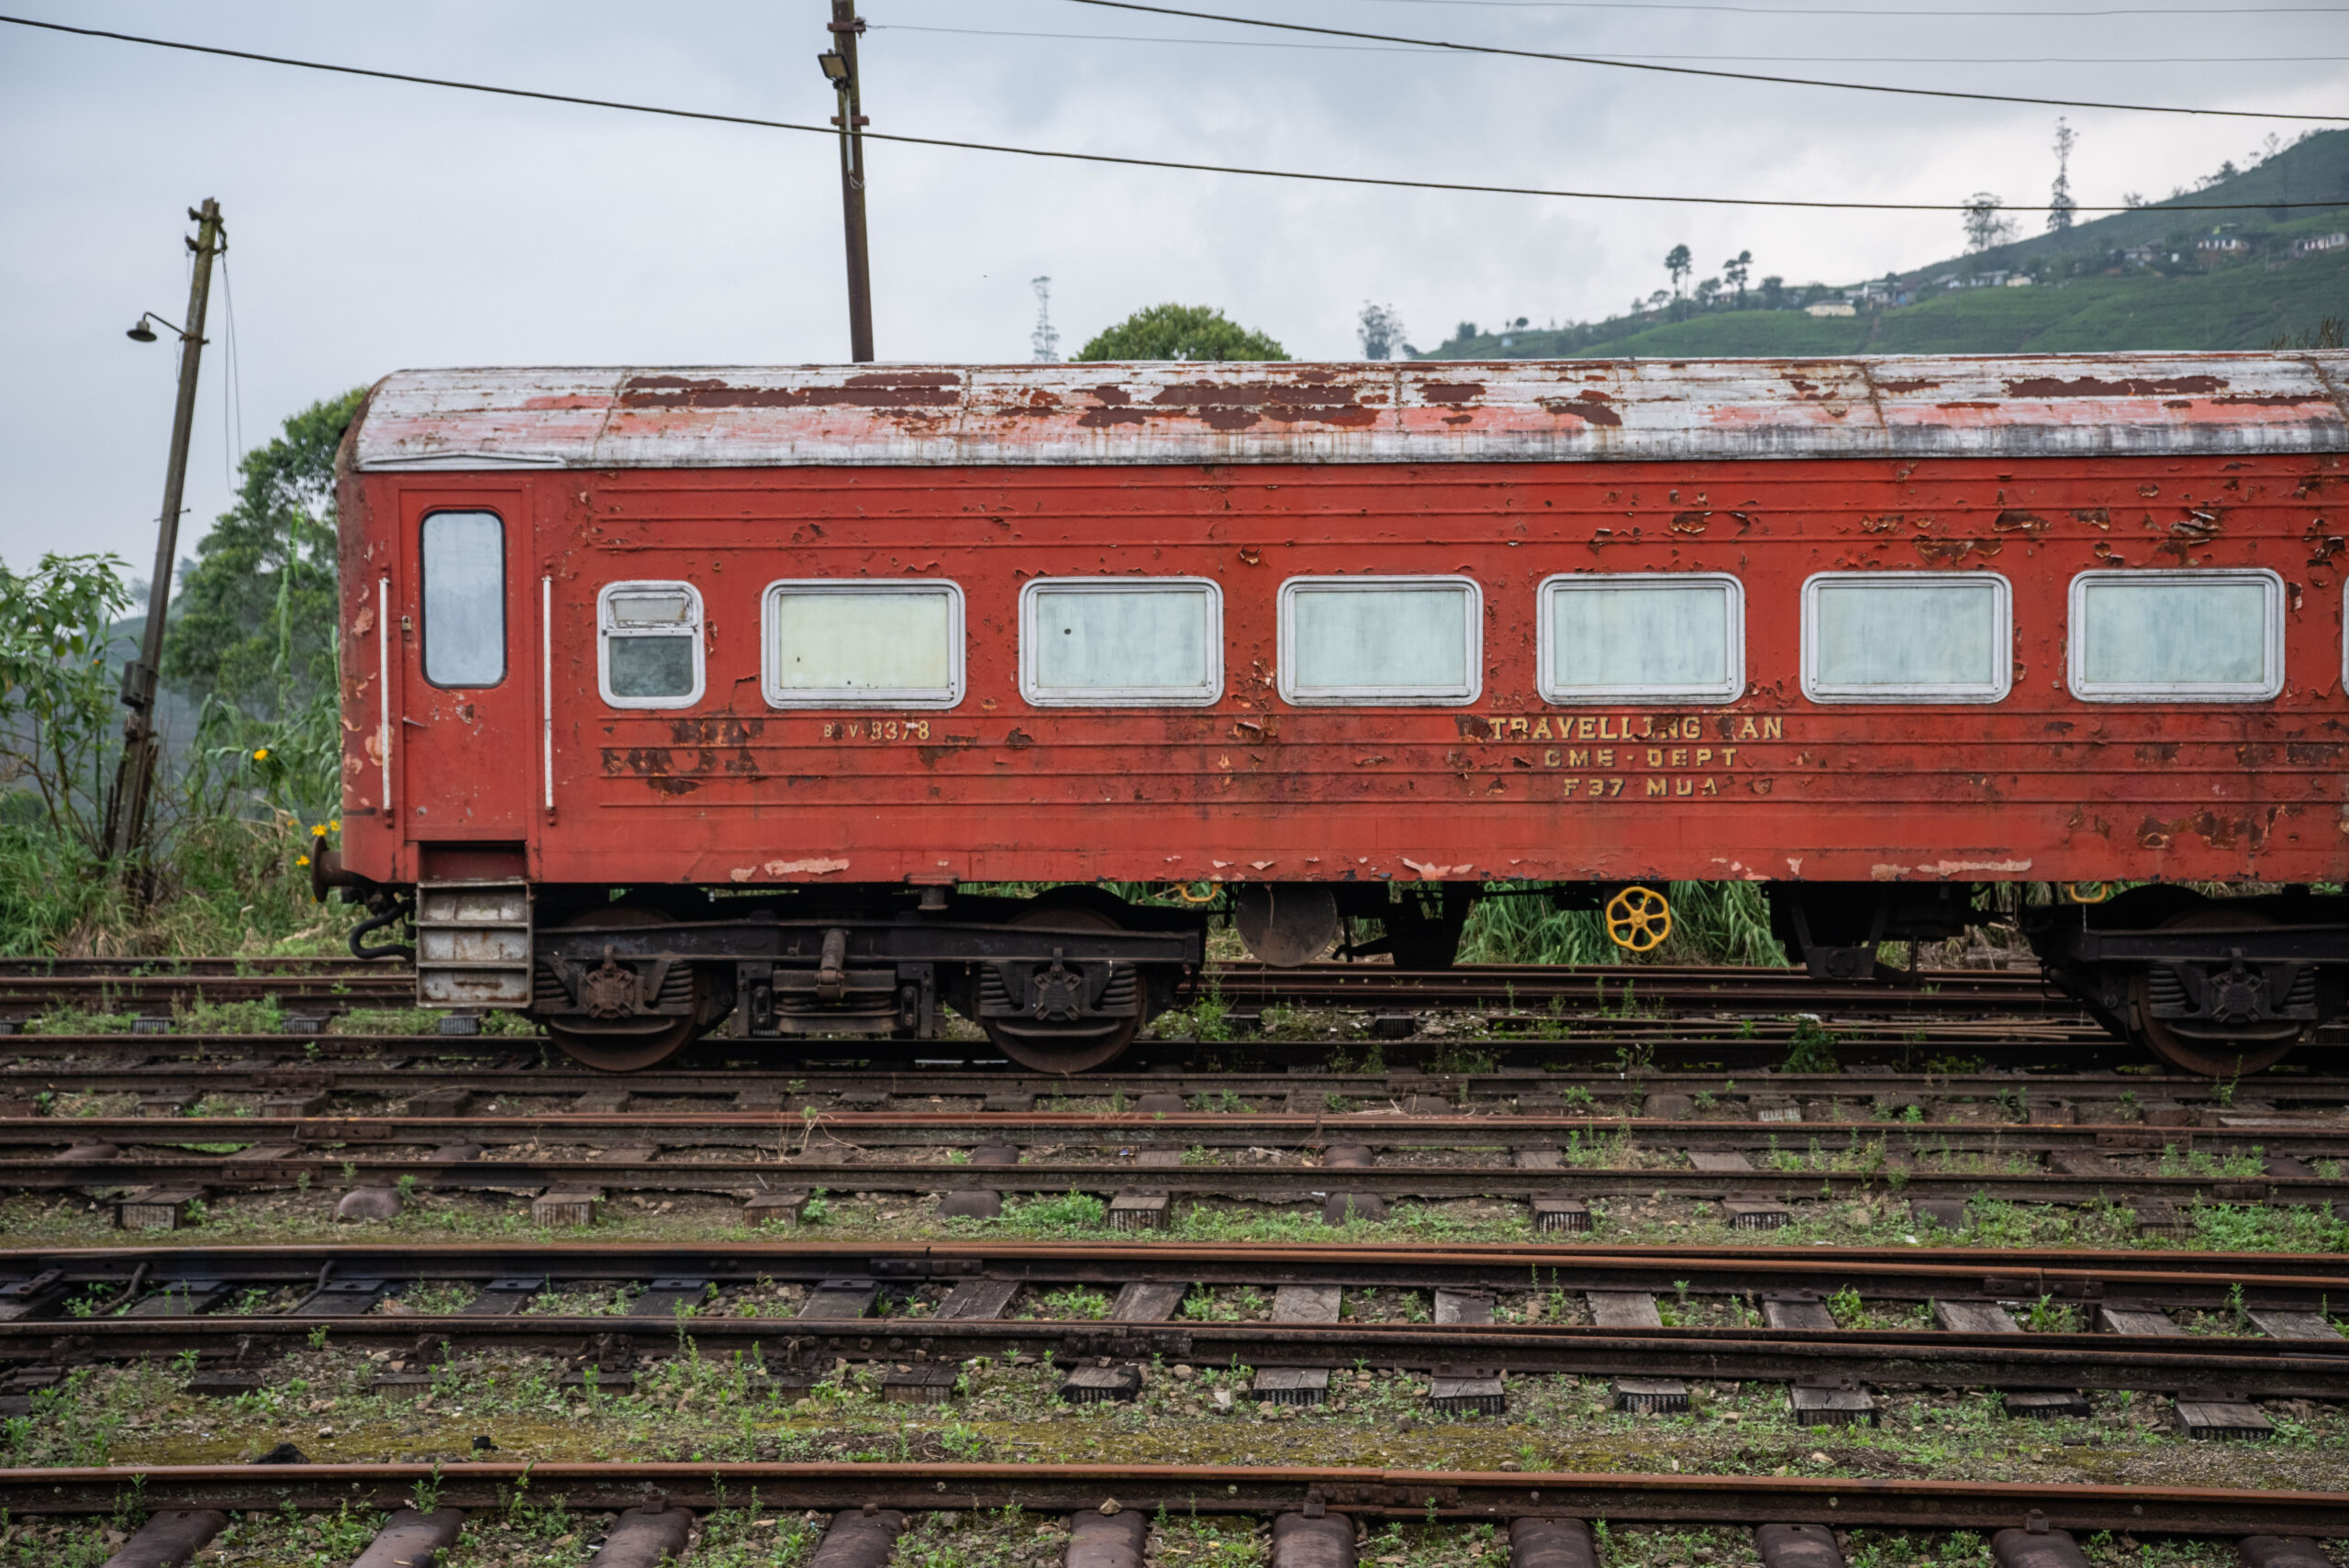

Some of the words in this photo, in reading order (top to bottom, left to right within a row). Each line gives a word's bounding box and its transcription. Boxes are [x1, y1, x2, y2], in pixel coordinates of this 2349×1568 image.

[824, 724, 859, 738] BV
[1720, 717, 1783, 740] AN
[1544, 749, 1614, 767] CME
[1647, 748, 1737, 767] DEPT
[1564, 778, 1625, 796] F37
